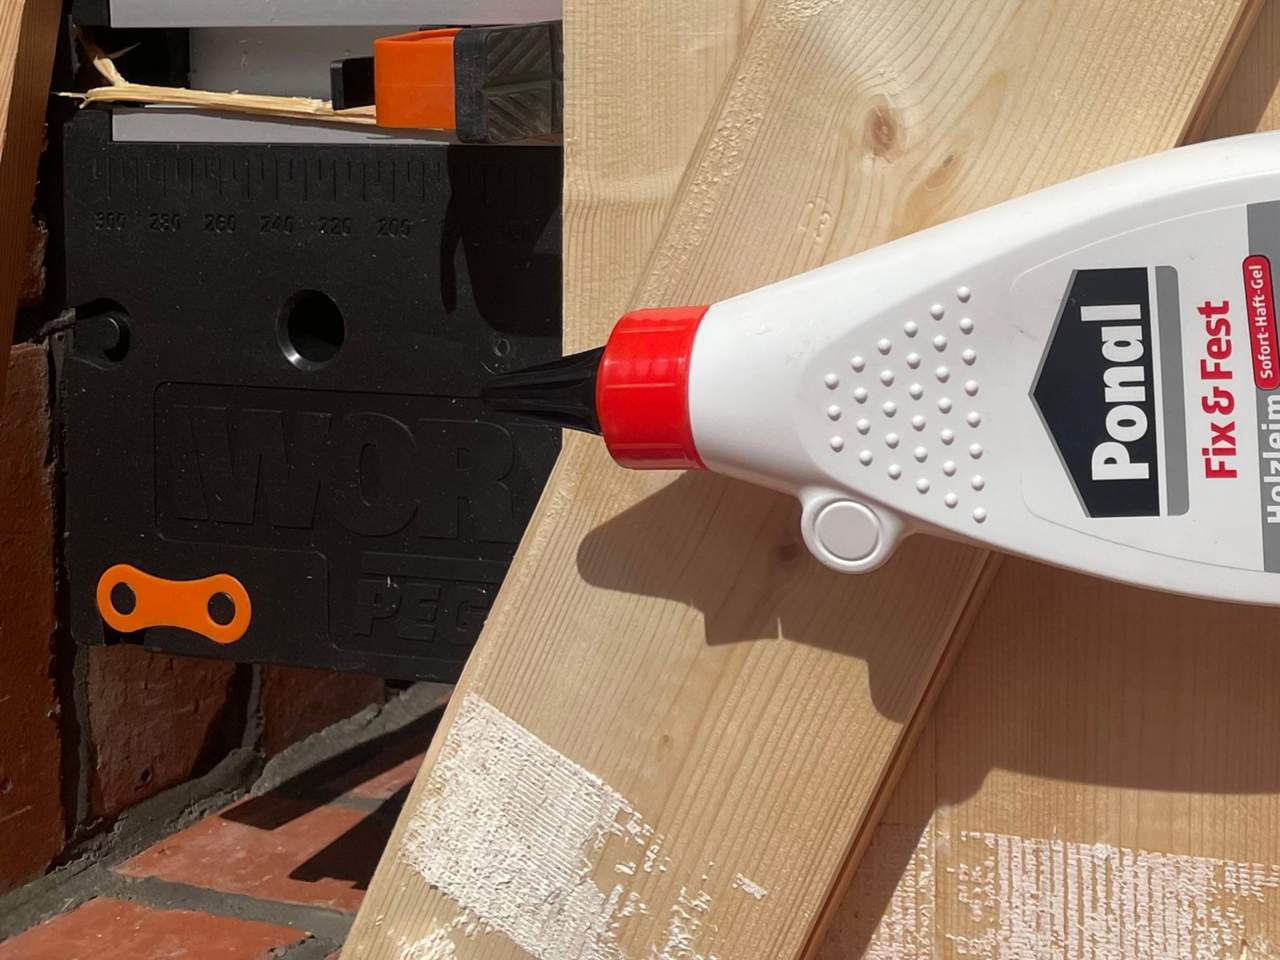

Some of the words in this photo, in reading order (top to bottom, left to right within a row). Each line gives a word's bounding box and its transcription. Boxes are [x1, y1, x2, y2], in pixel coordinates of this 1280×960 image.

[1197, 300, 1232, 380] Fest
[1249, 264, 1274, 379] Sofort-Haft-Gel
[1080, 304, 1150, 481] Ponal
[1201, 386, 1233, 415] &
[1201, 421, 1237, 479] Fix
